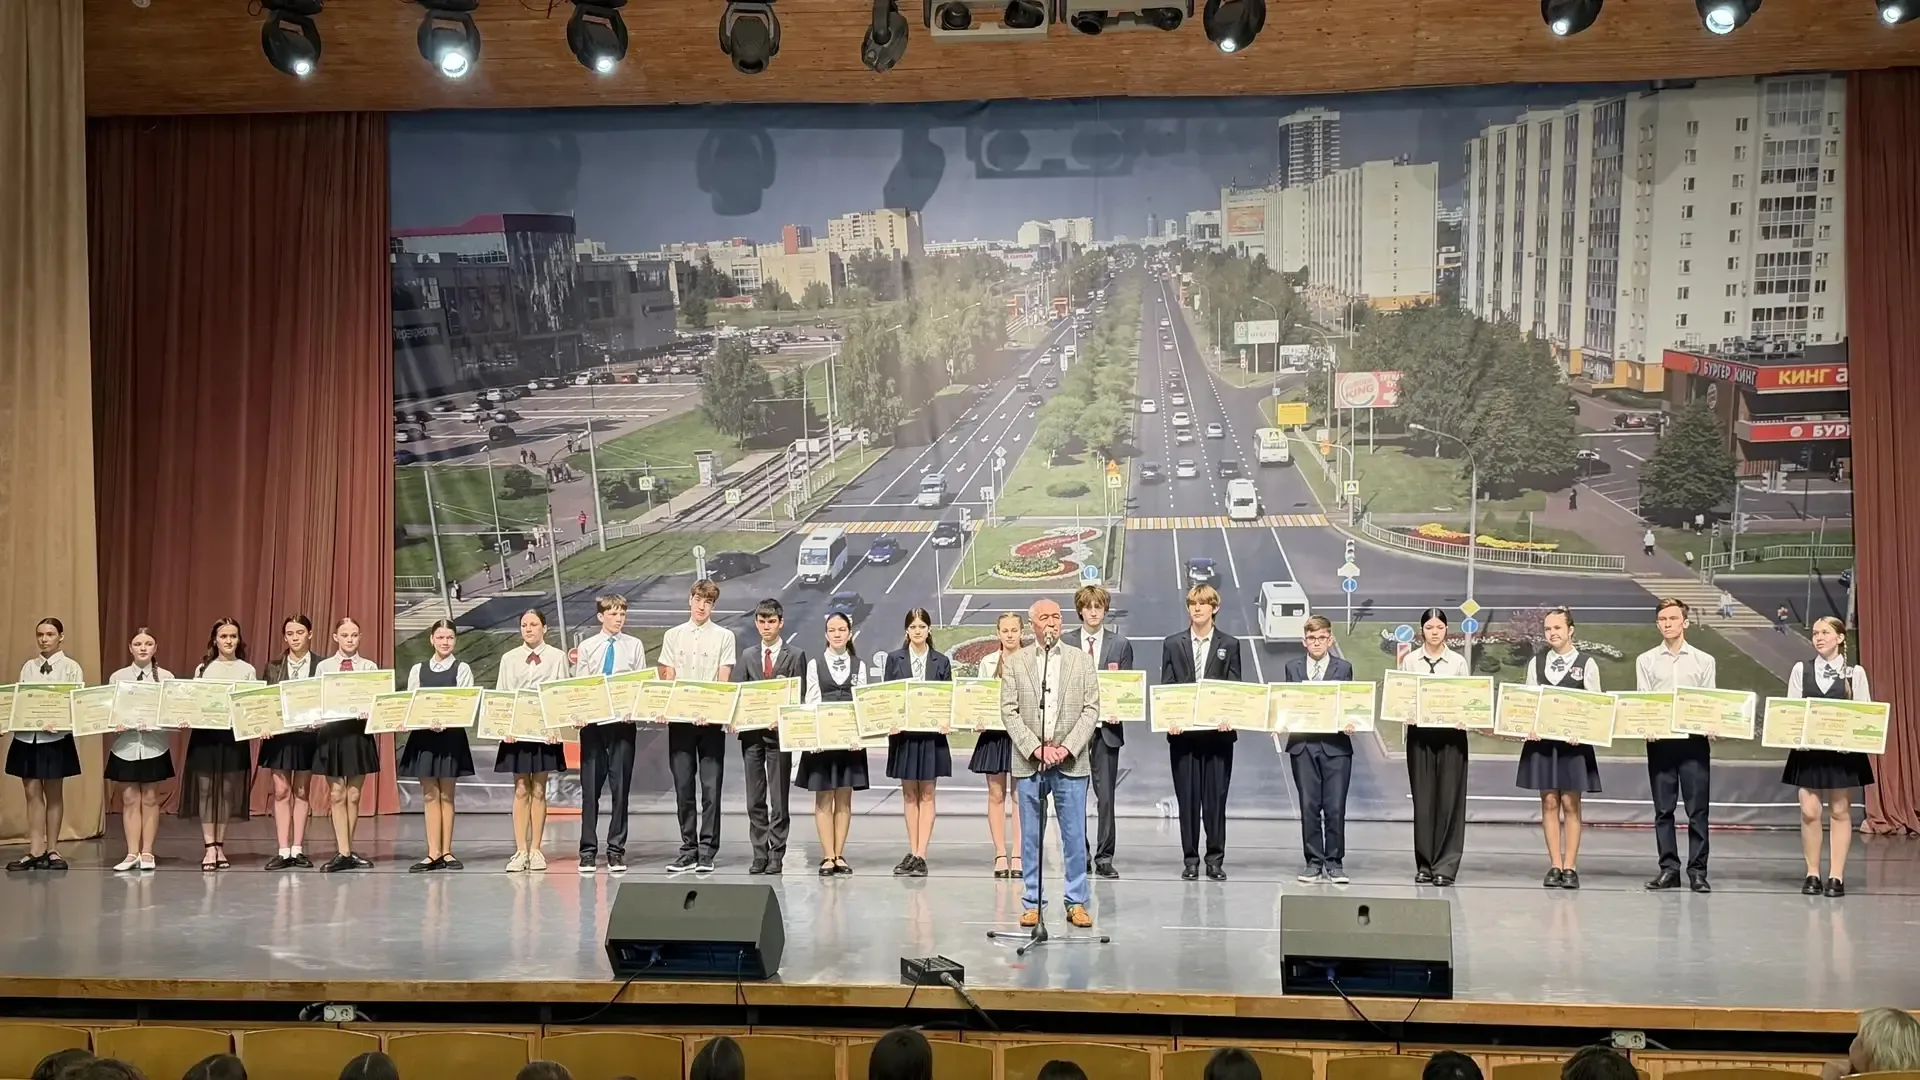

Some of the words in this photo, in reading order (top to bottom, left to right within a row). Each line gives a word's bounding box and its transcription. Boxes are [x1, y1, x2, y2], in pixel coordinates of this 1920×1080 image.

[1703, 361, 1731, 380] БУРГЕР
[1734, 367, 1757, 385] КИНГ
[1778, 368, 1832, 385] КИНГ
